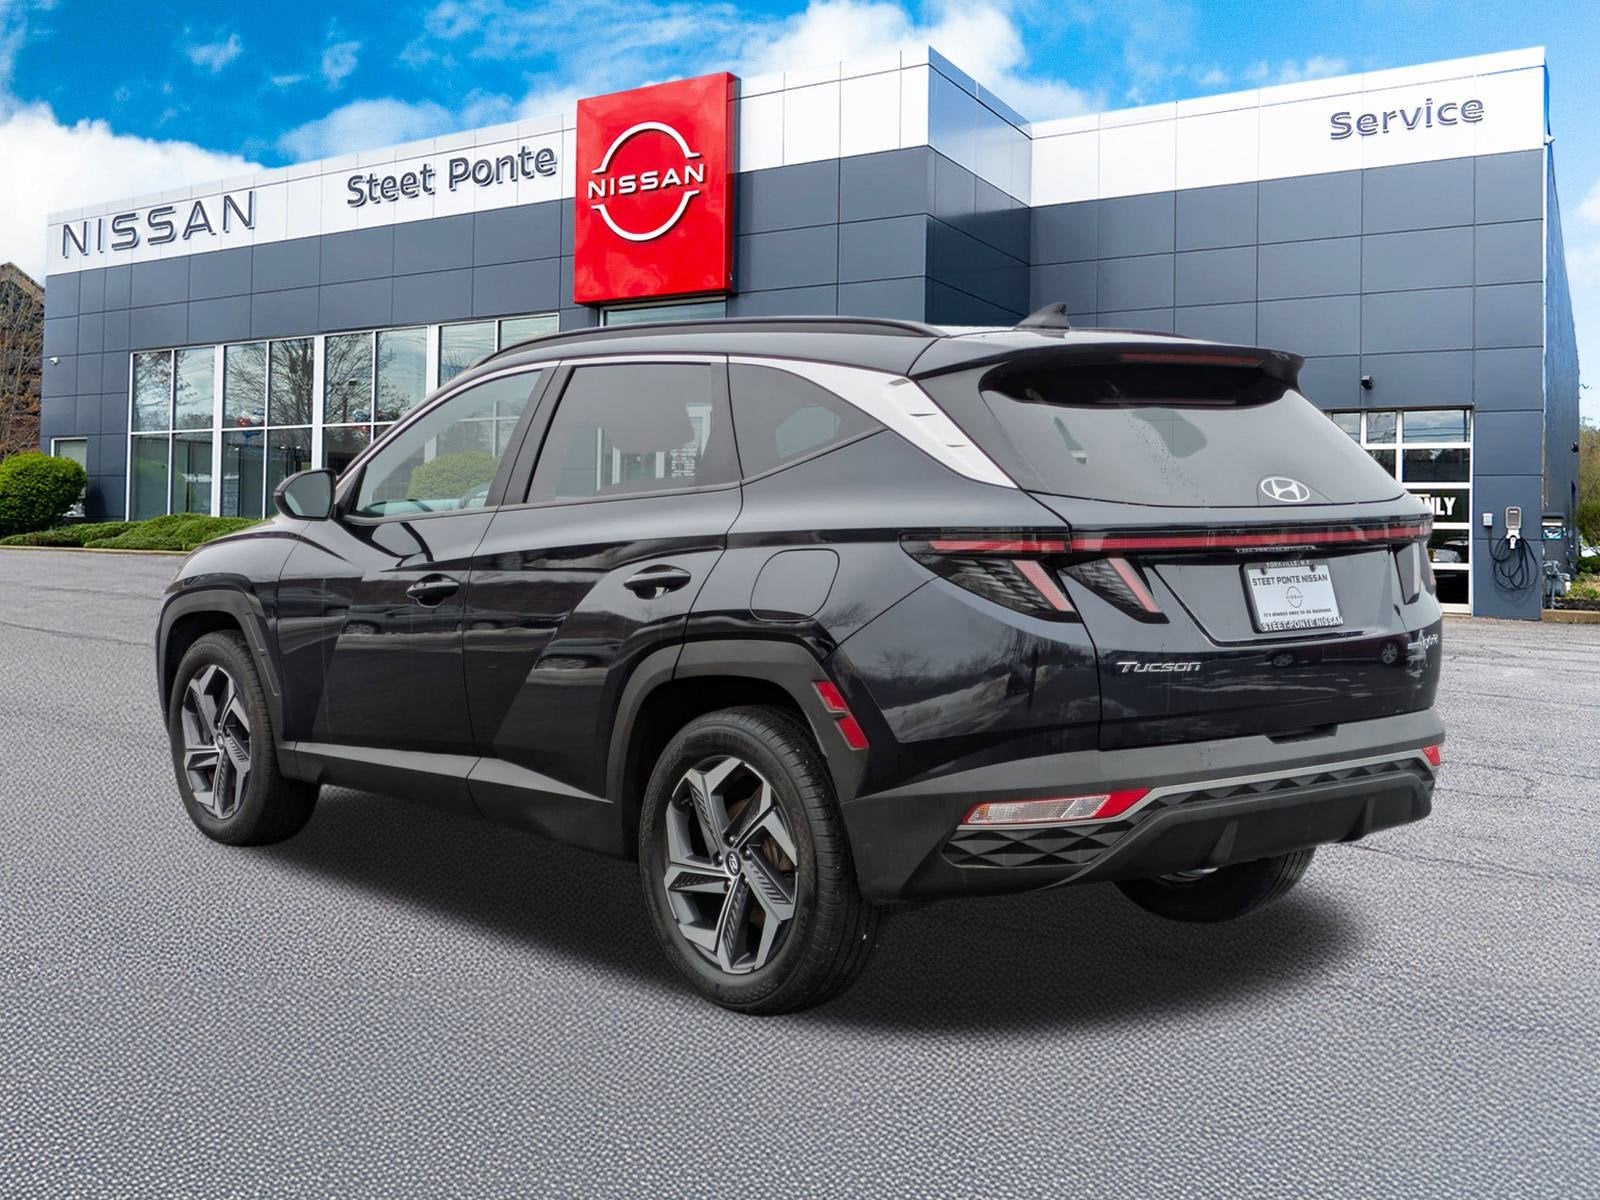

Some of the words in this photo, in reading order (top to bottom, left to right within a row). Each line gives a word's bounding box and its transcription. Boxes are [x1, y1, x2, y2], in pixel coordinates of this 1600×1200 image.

[1330, 98, 1485, 140] Service
[347, 163, 436, 207] Steet
[449, 145, 558, 191] Ponte
[587, 163, 705, 200] NISSAN
[62, 190, 256, 259] NISSAN
[1421, 496, 1457, 516] NLY
[1252, 575, 1276, 586] STEET
[1276, 574, 1301, 585] PONTE
[1301, 573, 1328, 583] NISSAN
[1316, 616, 1343, 627] NISSAN
